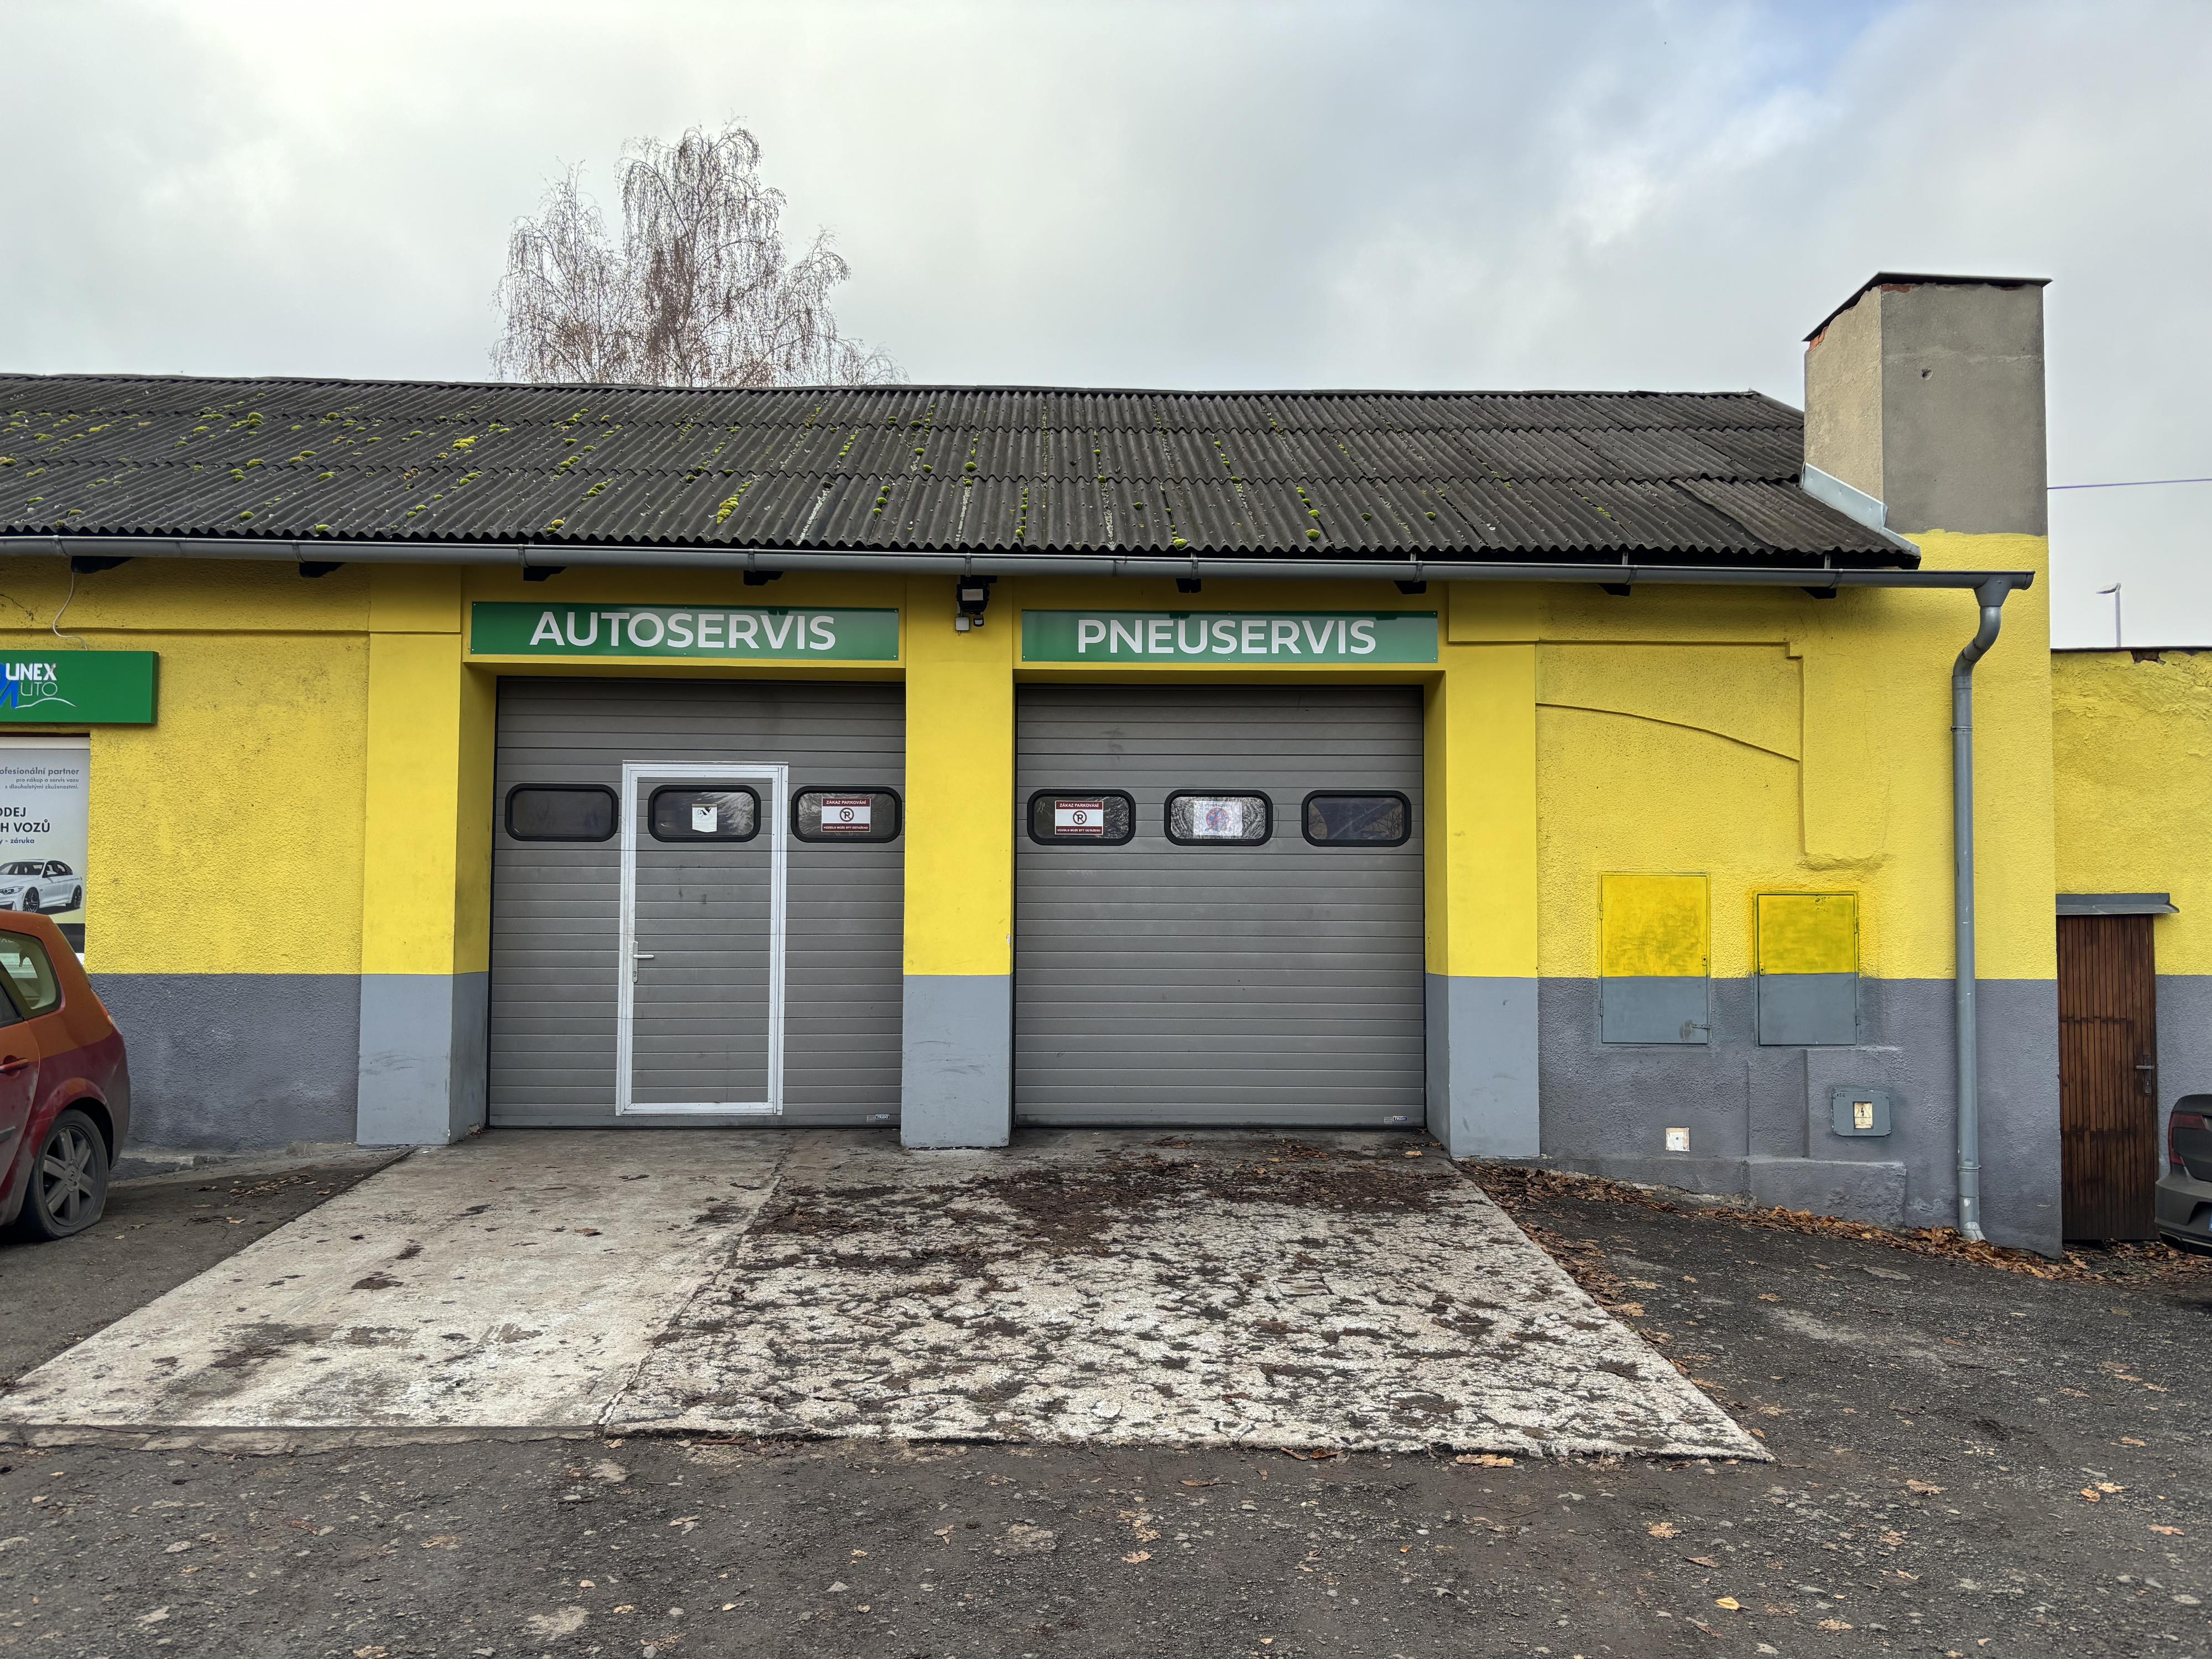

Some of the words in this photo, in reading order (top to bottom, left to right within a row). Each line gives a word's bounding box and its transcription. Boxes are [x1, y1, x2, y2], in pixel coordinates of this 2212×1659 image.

[529, 611, 836, 650] AUTOSERVIS
[1078, 619, 1376, 654] PNEUSERVIS
[48, 768, 79, 776] partner
[0, 807, 26, 817] DEJ
[13, 818, 50, 833] VOZŮ
